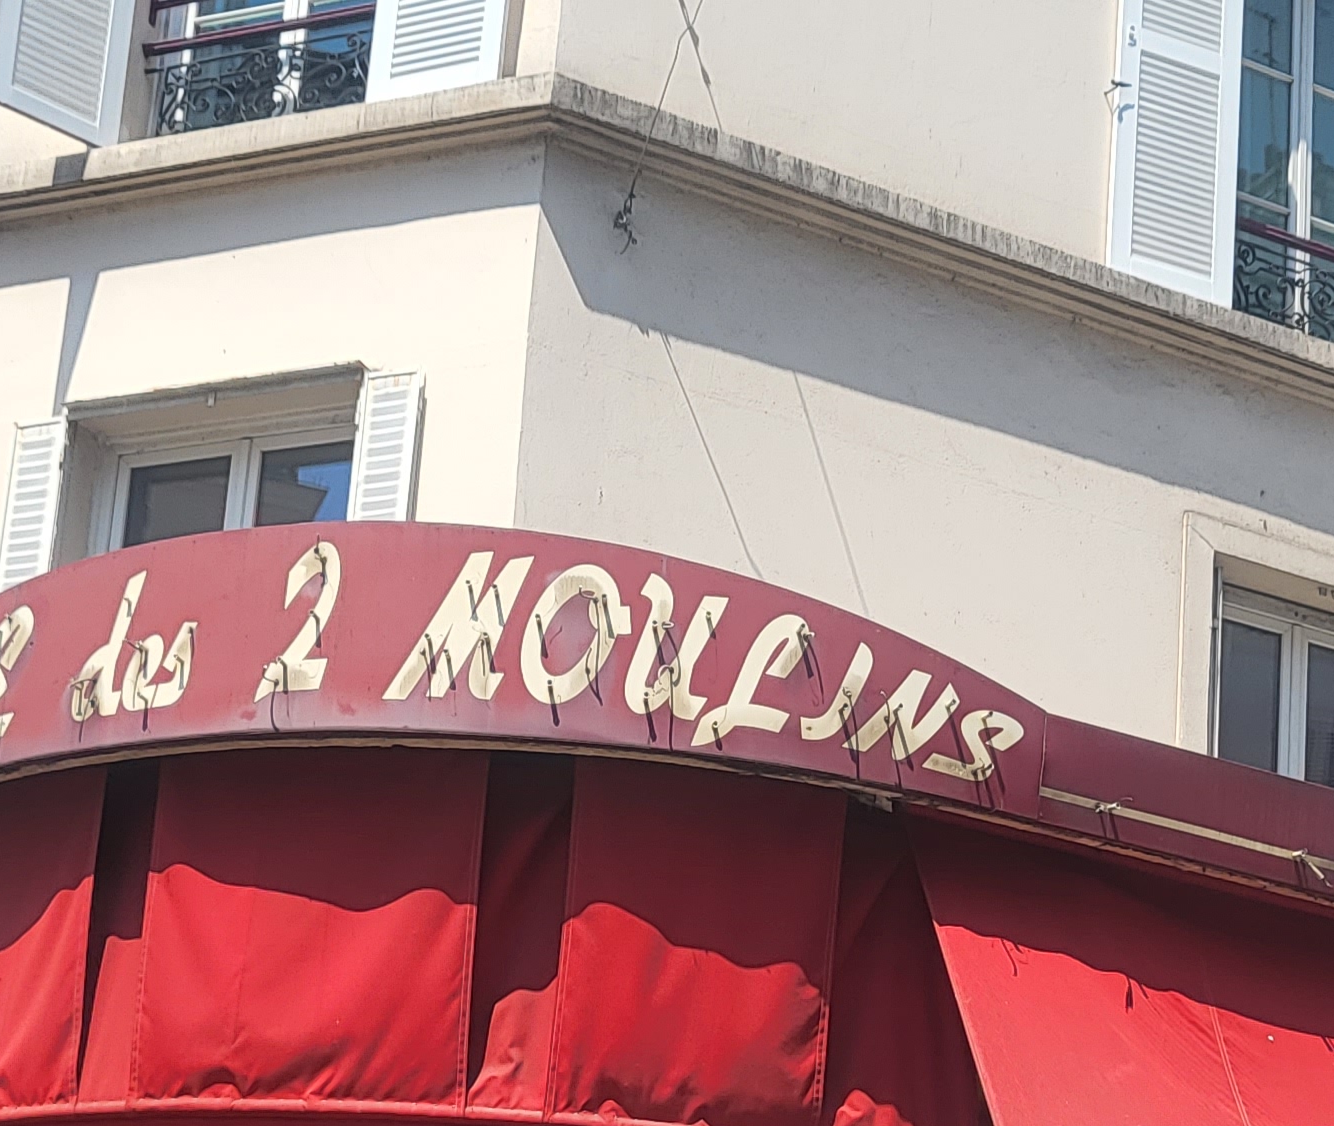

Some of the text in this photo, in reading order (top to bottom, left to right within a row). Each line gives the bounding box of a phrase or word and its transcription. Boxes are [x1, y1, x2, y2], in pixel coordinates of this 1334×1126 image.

[71, 570, 199, 722] des
[254, 541, 342, 703] 2
[383, 551, 1024, 781] MOULINS
